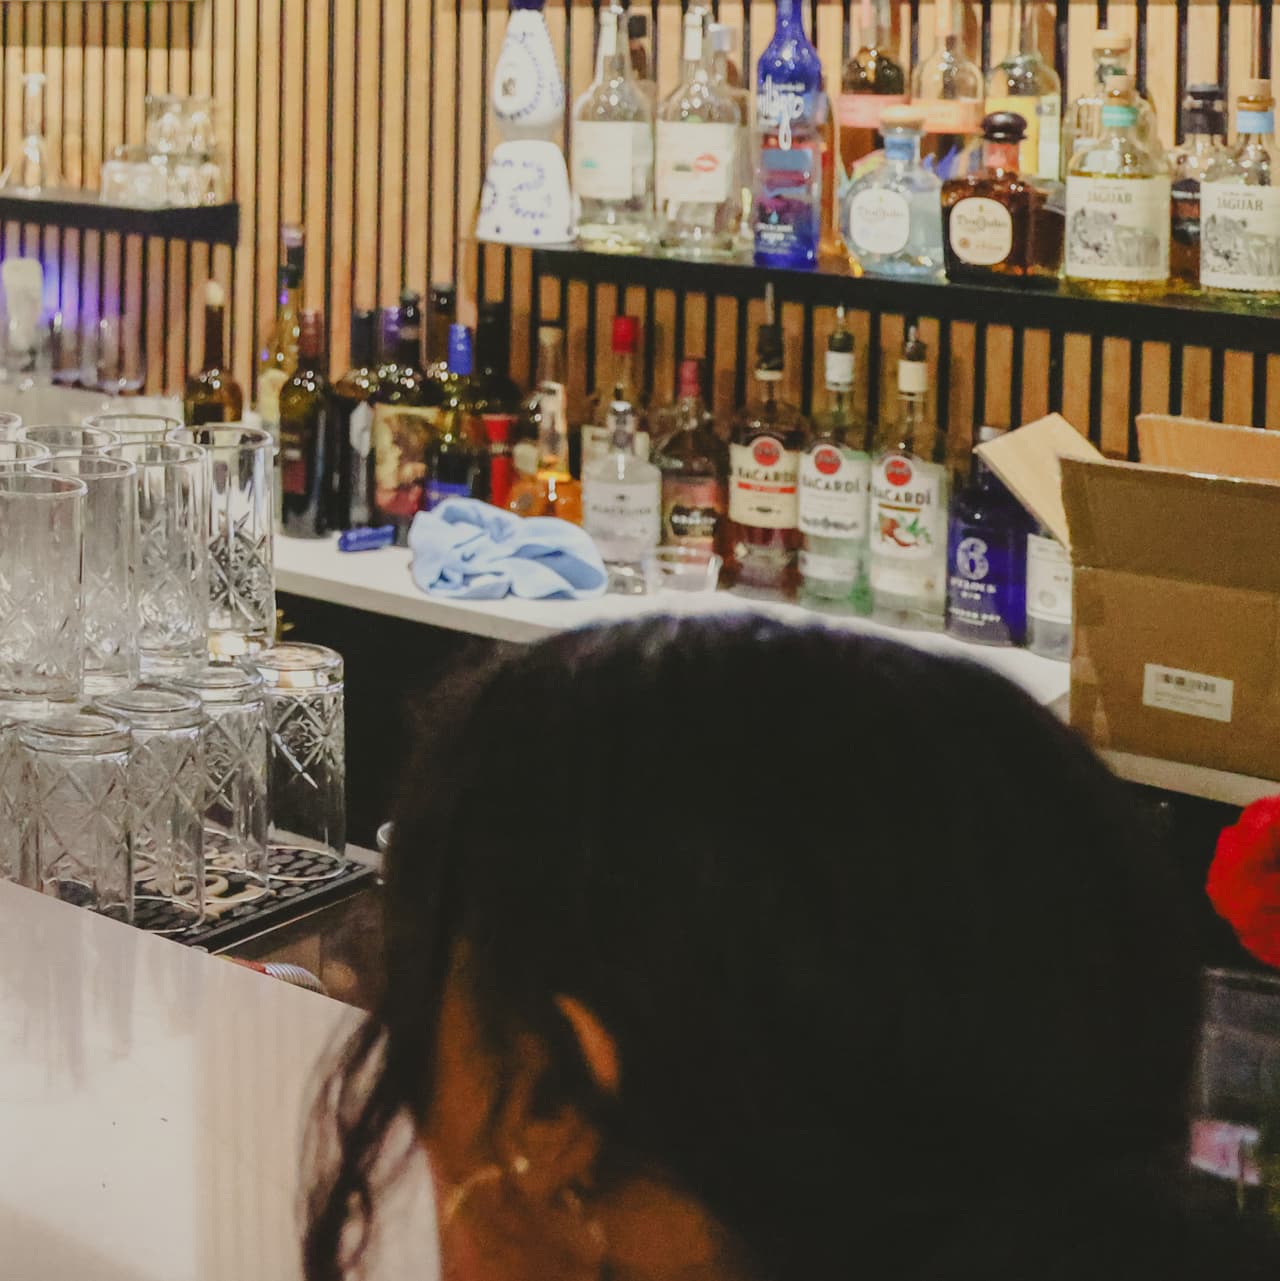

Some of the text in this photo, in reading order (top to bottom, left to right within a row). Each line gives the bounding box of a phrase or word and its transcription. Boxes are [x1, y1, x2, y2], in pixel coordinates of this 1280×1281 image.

[1086, 190, 1134, 204] JAGUAR
[1216, 196, 1264, 212] JAGUAR
[956, 536, 990, 580] 6
